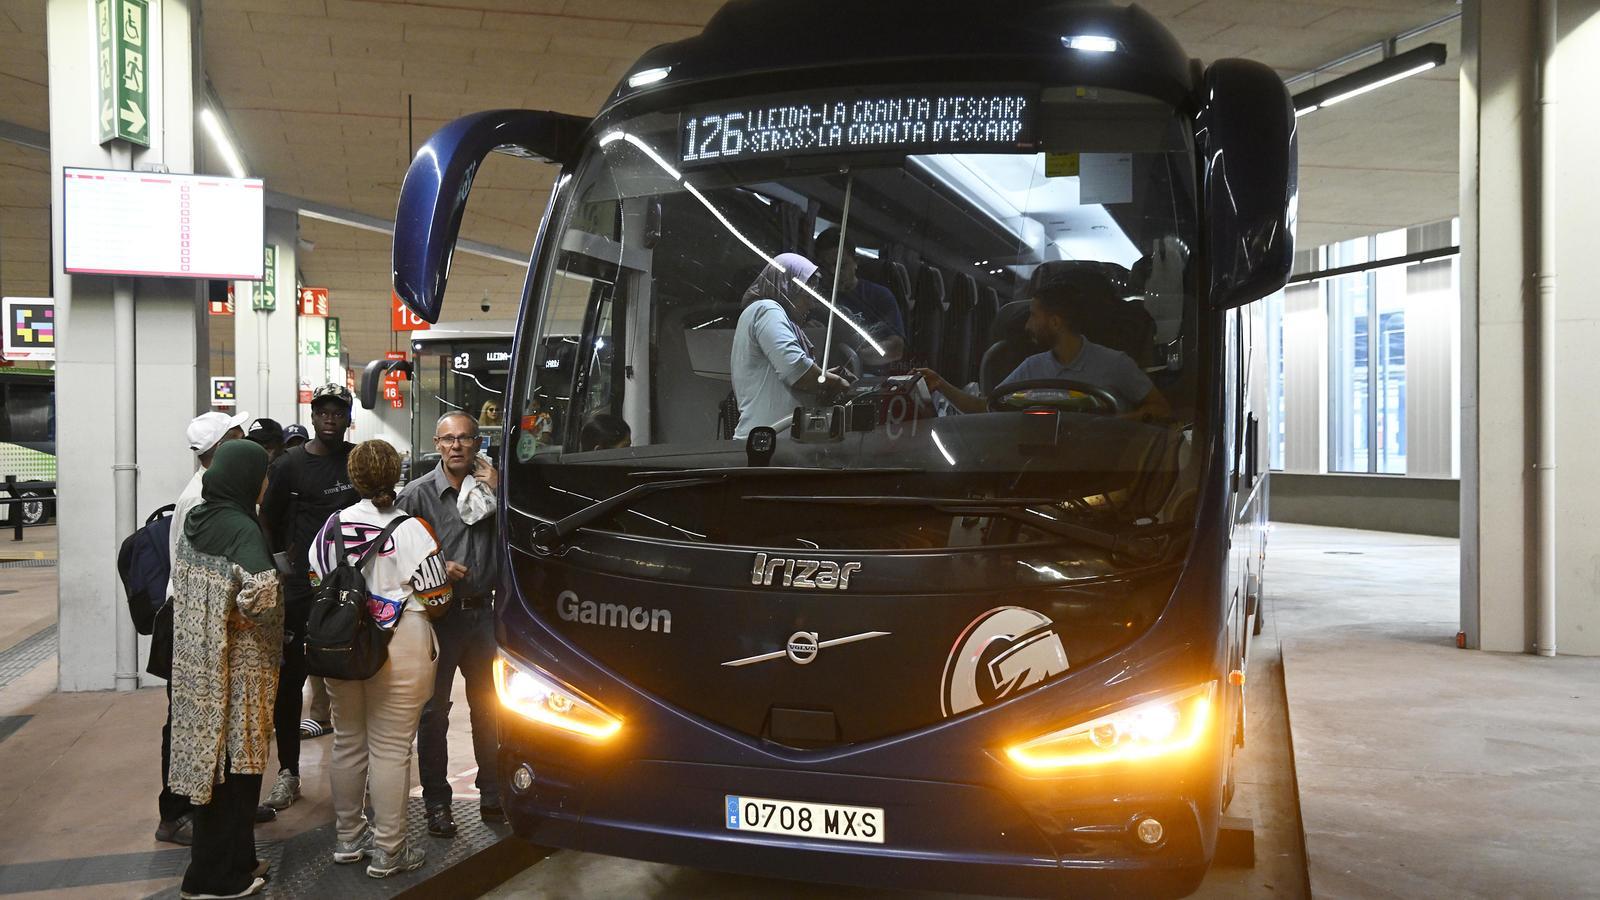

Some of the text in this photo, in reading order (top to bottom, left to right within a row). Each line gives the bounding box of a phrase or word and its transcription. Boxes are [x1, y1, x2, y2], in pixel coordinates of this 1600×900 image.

[747, 96, 1027, 132] LLEIDA-LA GRANJA D'ESCARP
[848, 121, 927, 145] GRANJA
[932, 119, 1023, 143] D'ESCARP
[683, 113, 745, 162] 126
[385, 387, 397, 398] 16
[752, 552, 862, 590] Irizar
[789, 644, 817, 652] VOLVO
[744, 802, 877, 838] 0708 MXS
